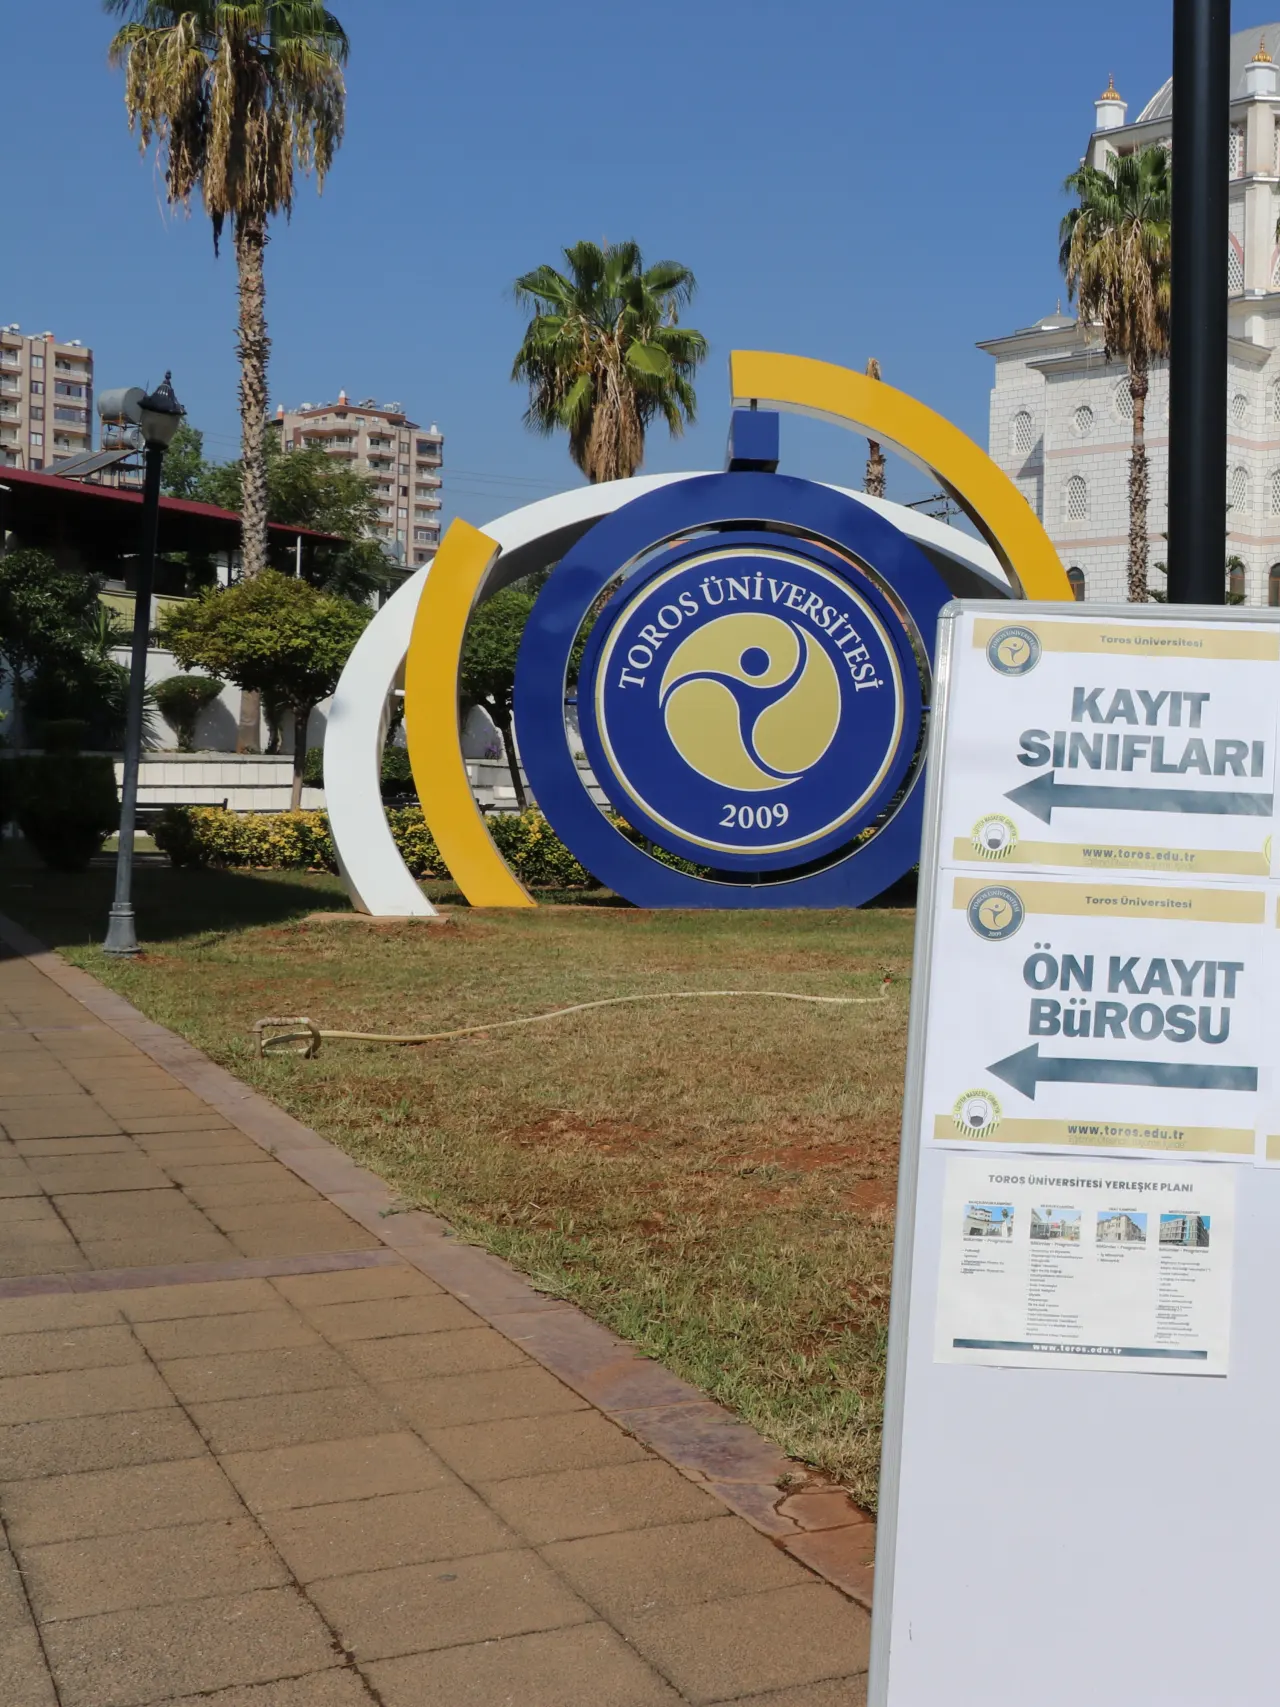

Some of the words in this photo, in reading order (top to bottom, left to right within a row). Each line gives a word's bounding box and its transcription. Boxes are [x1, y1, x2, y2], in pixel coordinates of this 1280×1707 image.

[618, 591, 700, 690] TOROS
[699, 571, 884, 692] ÜNİVERSİTESİ
[1100, 635, 1132, 645] Toros
[1134, 636, 1203, 648] Üniversitesi
[1071, 686, 1210, 728] KAYIT
[1016, 729, 1265, 777] SINIFLARI
[719, 803, 789, 829] 2009
[1083, 848, 1196, 862] www.toros.edu.tr
[1085, 896, 1118, 906] Toros
[1120, 896, 1192, 908] Üniversitesi
[1023, 942, 1094, 992] ÖN
[1107, 956, 1244, 999] KAYIT
[1068, 1125, 1185, 1140] www.toros.edu.tr
[1028, 1174, 1102, 1188] ÜNİVERSİTESİ
[1104, 1180, 1158, 1192] YERLEŞKE
[1160, 1183, 1193, 1192] PLANI
[1032, 1343, 1122, 1354] www.toros.edu.tr
